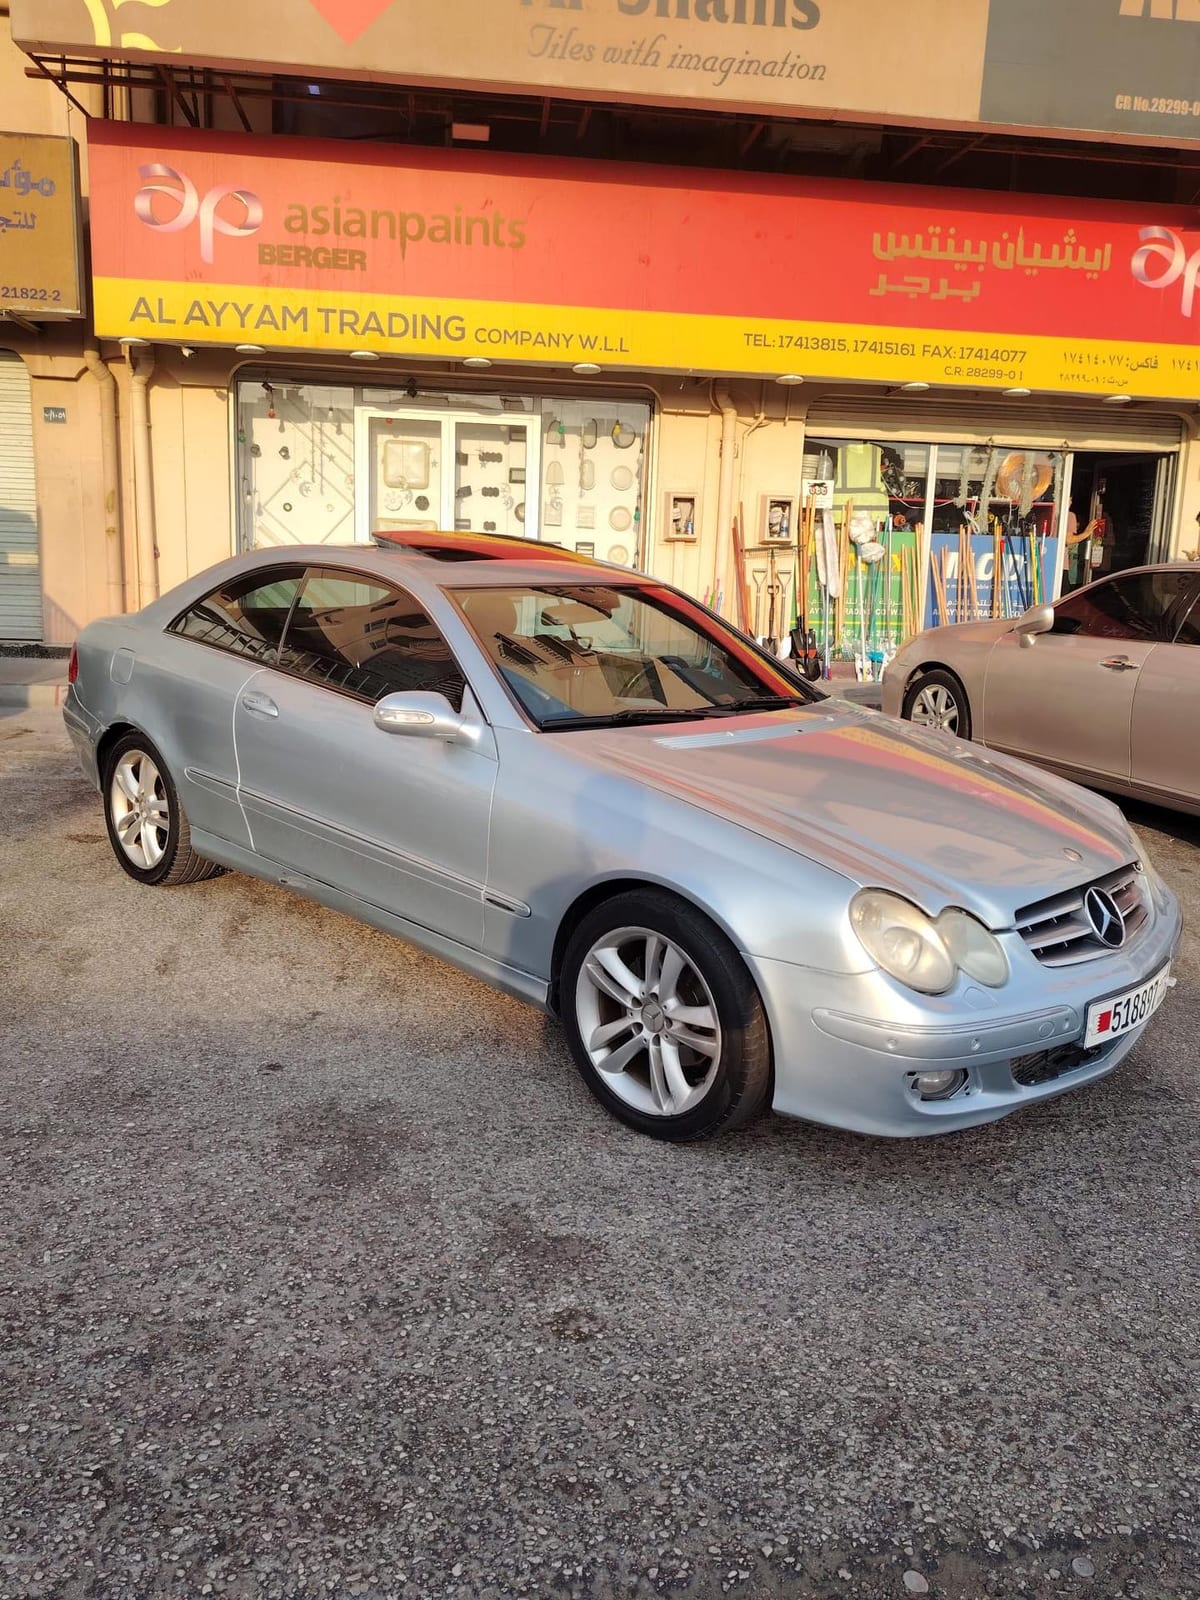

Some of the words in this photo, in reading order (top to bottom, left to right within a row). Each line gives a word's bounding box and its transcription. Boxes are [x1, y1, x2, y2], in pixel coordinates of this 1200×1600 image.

[527, 23, 596, 62] Tiles
[602, 33, 667, 68] with
[666, 44, 828, 87] imagination
[1115, 94, 1132, 111] CR
[283, 196, 528, 261] asianpaints
[258, 243, 368, 272] BERGER
[872, 225, 988, 273] بينتس
[1, 286, 61, 301] 21822-2
[868, 273, 981, 303] برجر
[129, 296, 176, 325] AL
[183, 299, 309, 332] AYYAM
[316, 307, 467, 342] TRADING
[474, 327, 575, 349] COMPANY
[579, 334, 631, 353] W.L.L
[853, 339, 916, 356] 17415161
